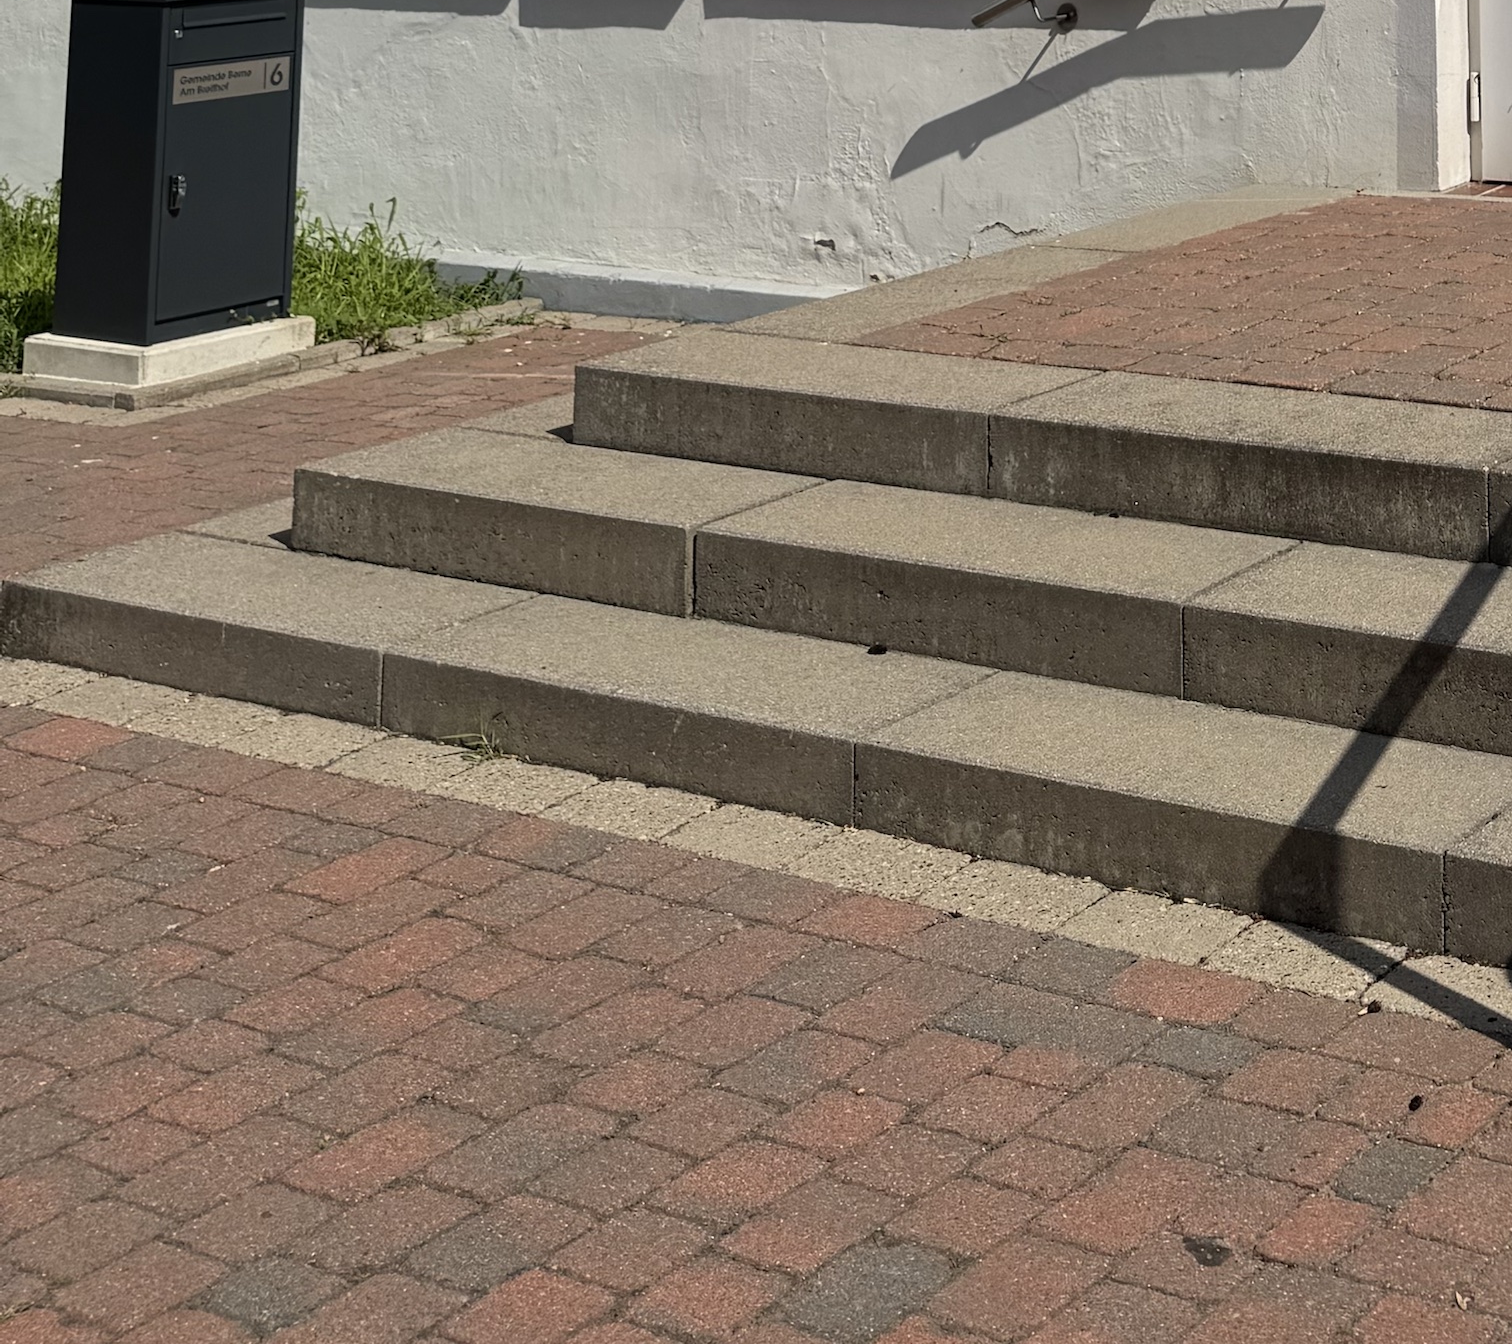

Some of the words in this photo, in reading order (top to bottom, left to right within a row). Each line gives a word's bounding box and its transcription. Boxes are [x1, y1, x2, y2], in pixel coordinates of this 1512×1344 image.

[180, 72, 227, 85] Gemeinde
[228, 69, 253, 80] Berne
[270, 63, 284, 86] 6
[180, 87, 196, 96] Am
